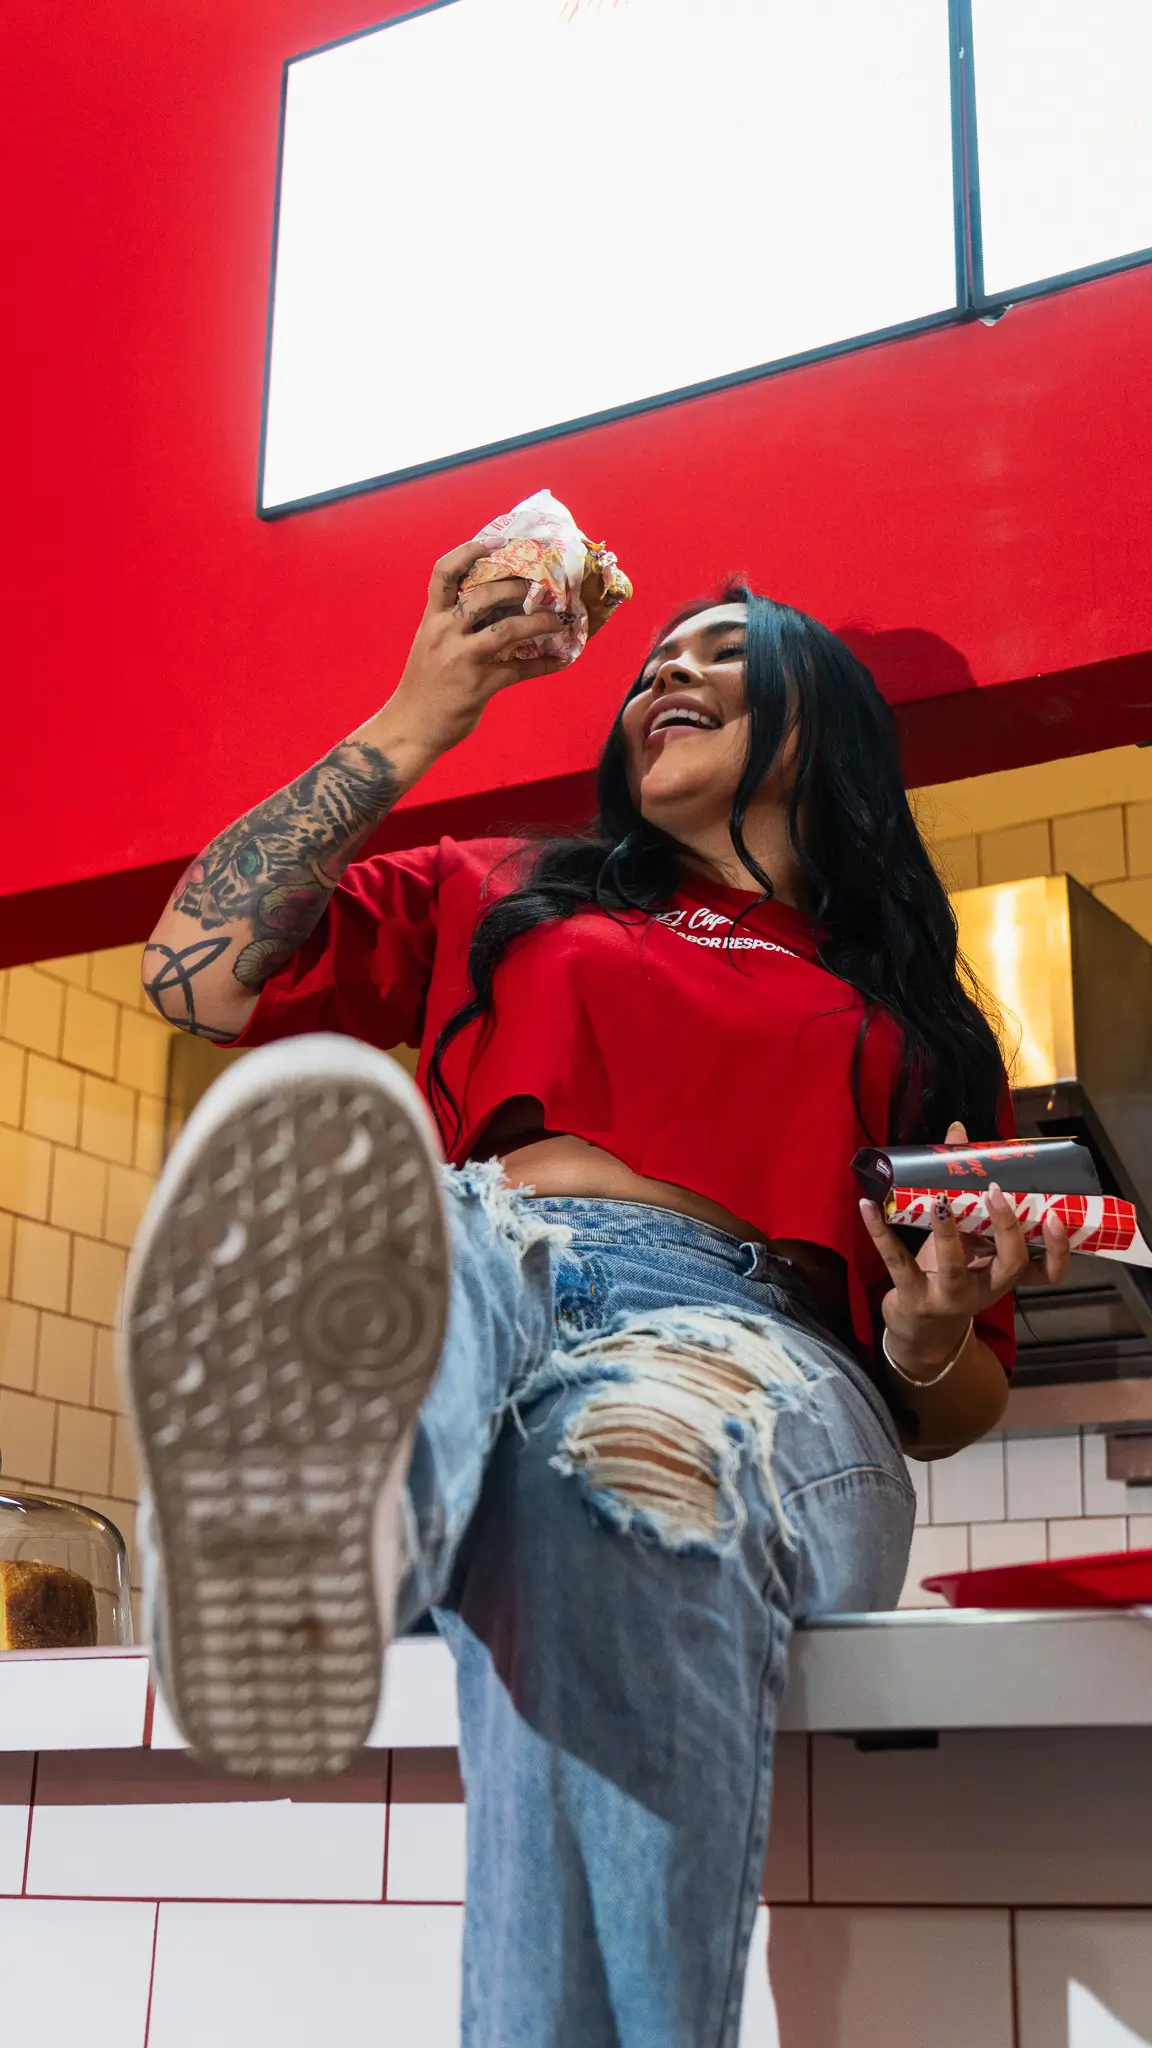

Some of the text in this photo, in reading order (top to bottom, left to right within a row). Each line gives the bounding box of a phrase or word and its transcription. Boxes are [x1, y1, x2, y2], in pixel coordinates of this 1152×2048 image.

[688, 907, 736, 931] Cap
[668, 926, 800, 958] ABOR RESPON
